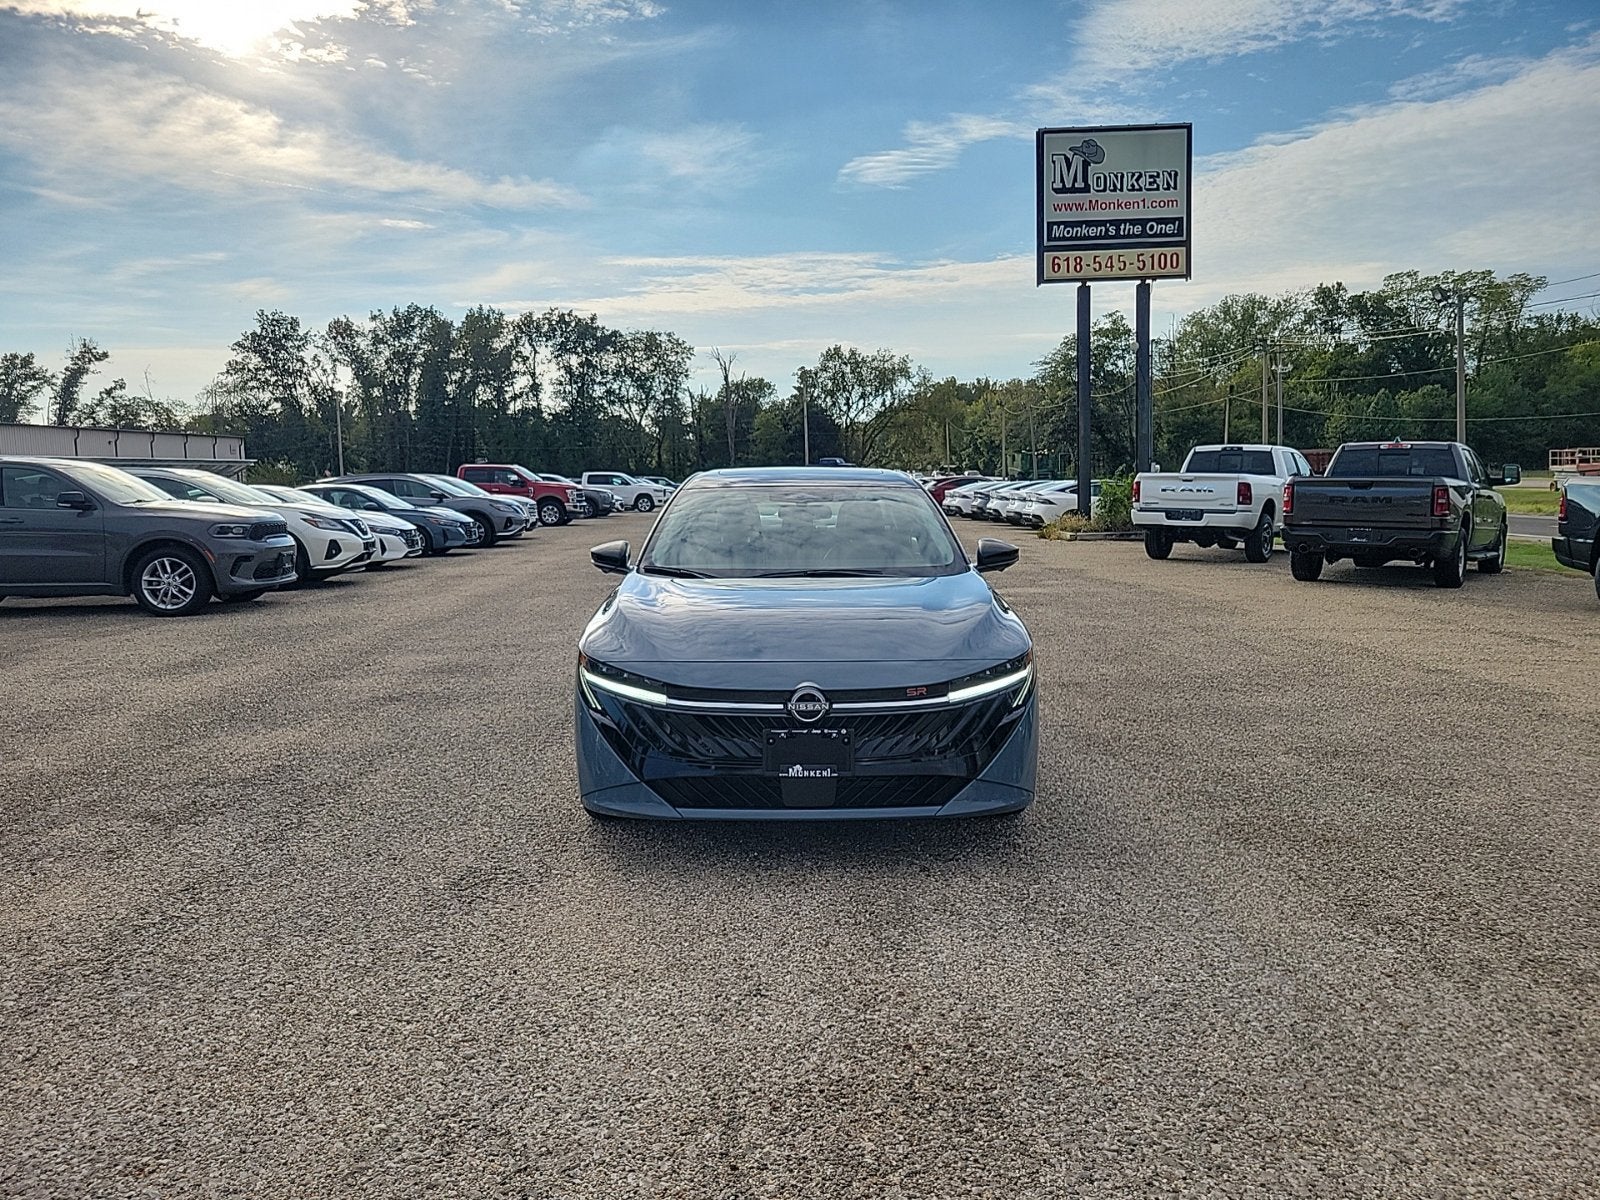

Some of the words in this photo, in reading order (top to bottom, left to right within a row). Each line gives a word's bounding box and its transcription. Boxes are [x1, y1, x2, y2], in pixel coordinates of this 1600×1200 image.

[1053, 198, 1179, 212] www.Monken1.com
[1052, 224, 1116, 238] Monken's
[1120, 222, 1142, 235] the
[1146, 221, 1179, 235] One!
[1051, 252, 1180, 274] 618-545-5100
[1160, 486, 1214, 494] RAM
[1329, 495, 1393, 504] RAM
[906, 687, 928, 697] SR
[787, 703, 830, 711] NISSAN
